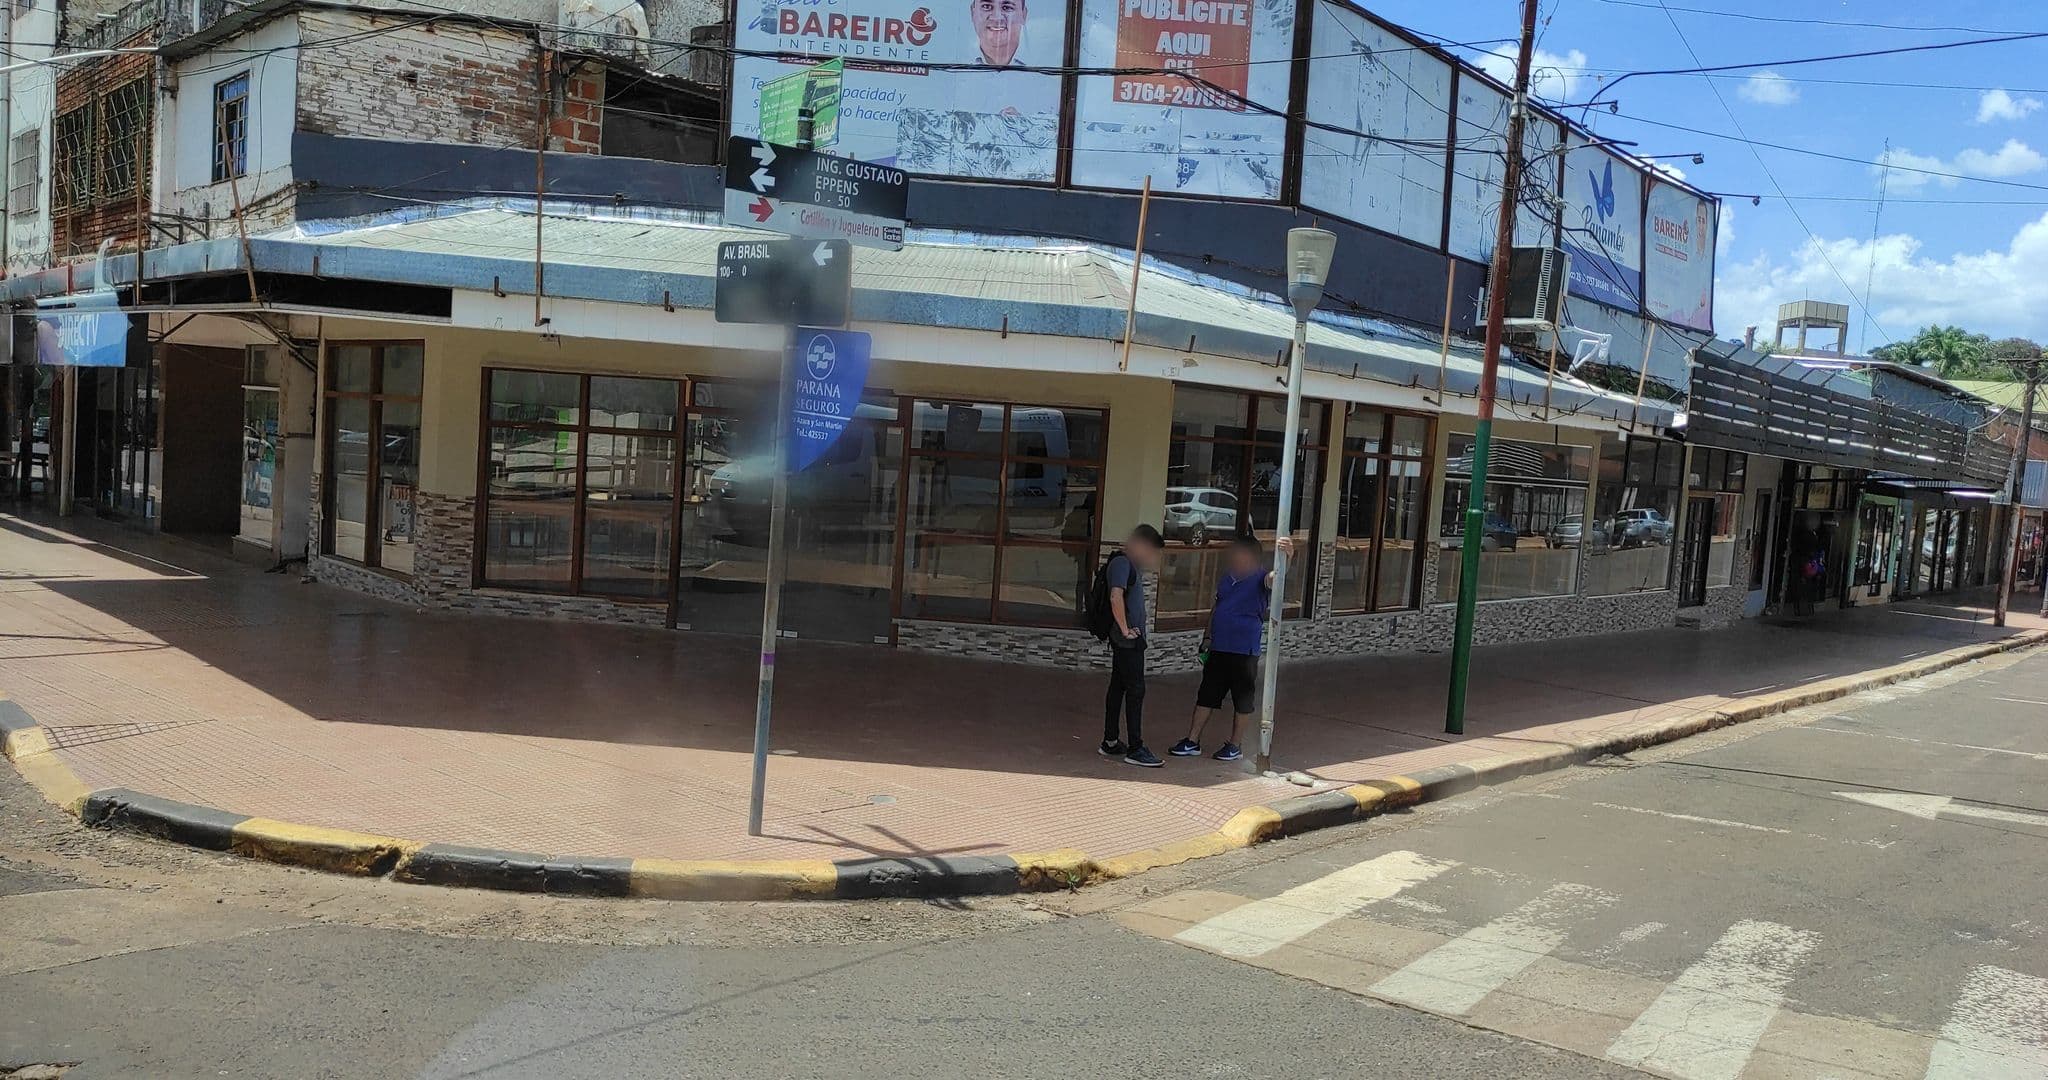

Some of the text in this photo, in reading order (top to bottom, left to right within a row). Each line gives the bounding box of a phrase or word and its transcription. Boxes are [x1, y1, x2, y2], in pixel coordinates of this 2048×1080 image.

[1124, 0, 1247, 26] PUBLICITE
[779, 8, 936, 47] BAREIRO
[778, 38, 929, 61] INTENDENTE
[1155, 31, 1211, 56] AQUI
[842, 87, 907, 106] pacidad y
[816, 157, 904, 186] ING. GUSTAVO
[815, 175, 859, 196] EPPENS
[838, 195, 850, 208] 50
[1654, 215, 1689, 243] BAREIRO
[723, 244, 770, 260] AV. BRASIL
[741, 264, 748, 277] 0
[57, 312, 100, 349] DIRECTV
[796, 379, 841, 399] PARANA
[795, 398, 841, 415] SEGUROS
